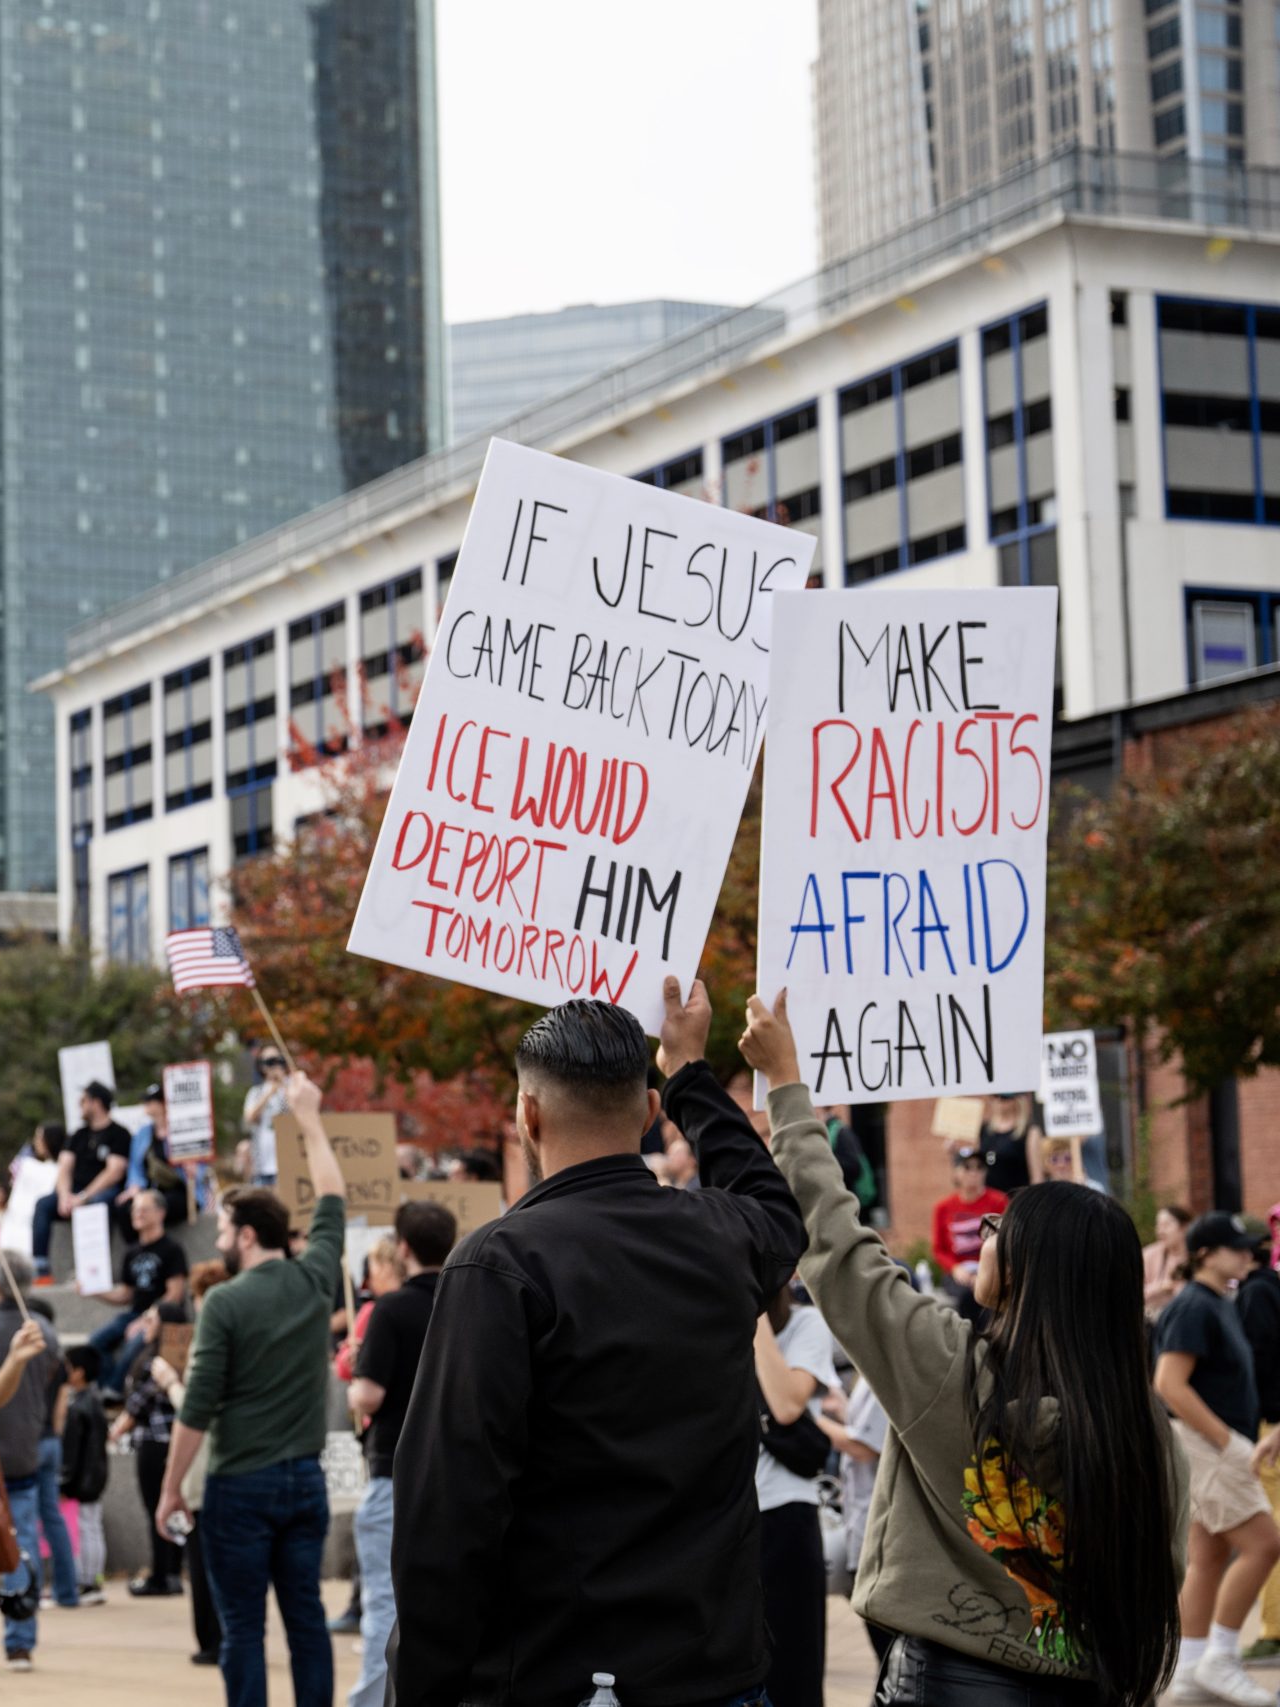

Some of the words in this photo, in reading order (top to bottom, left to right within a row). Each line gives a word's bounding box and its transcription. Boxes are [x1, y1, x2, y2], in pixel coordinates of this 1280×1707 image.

[502, 499, 568, 586] IF
[592, 523, 796, 653] JESUS
[446, 610, 556, 702] CAME
[563, 632, 666, 737] BACK
[667, 649, 768, 771] TODAY
[838, 619, 1000, 713] MAKE
[426, 713, 511, 814] ICE
[809, 712, 1043, 843] RACISTS
[391, 809, 568, 922] DEPORT
[573, 855, 683, 962] HIM
[786, 858, 1030, 979] AFRAID
[411, 900, 640, 1007] TOMORROW
[810, 983, 994, 1094] AGAIN
[1047, 1037, 1088, 1060] NO
